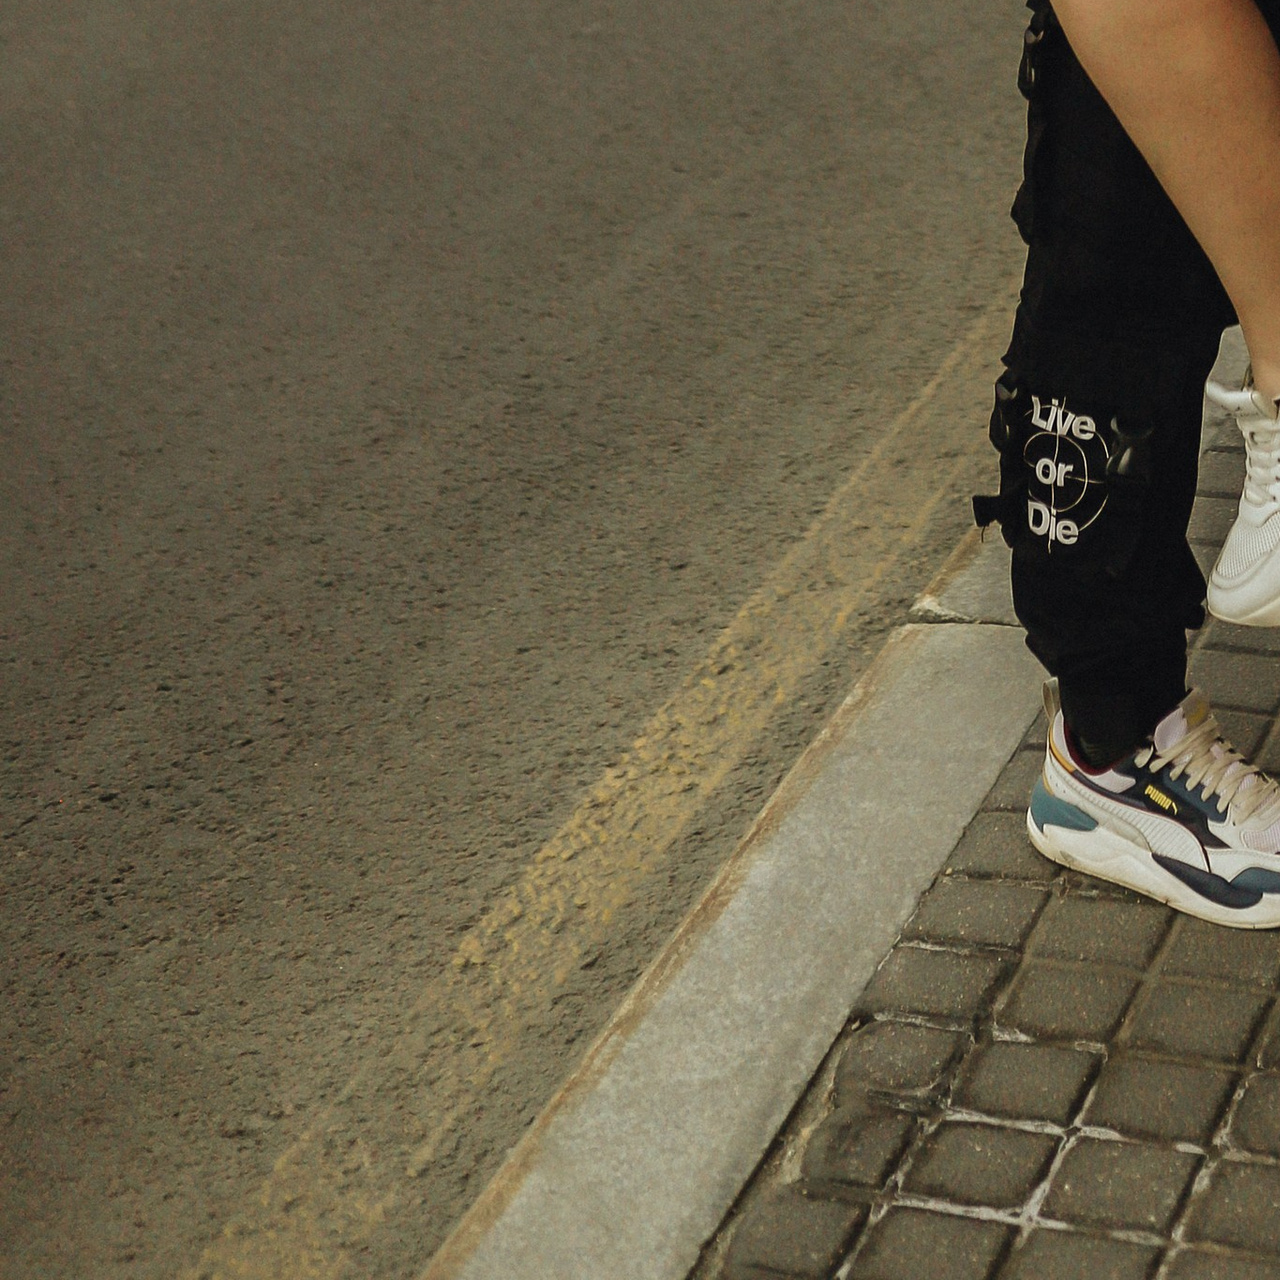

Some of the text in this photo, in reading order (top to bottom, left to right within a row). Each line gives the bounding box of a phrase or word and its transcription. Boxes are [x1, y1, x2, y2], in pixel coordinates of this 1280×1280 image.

[1031, 395, 1096, 440] Live
[1035, 457, 1073, 487] or
[1027, 498, 1079, 545] Die
[1144, 784, 1173, 810] PUMA
